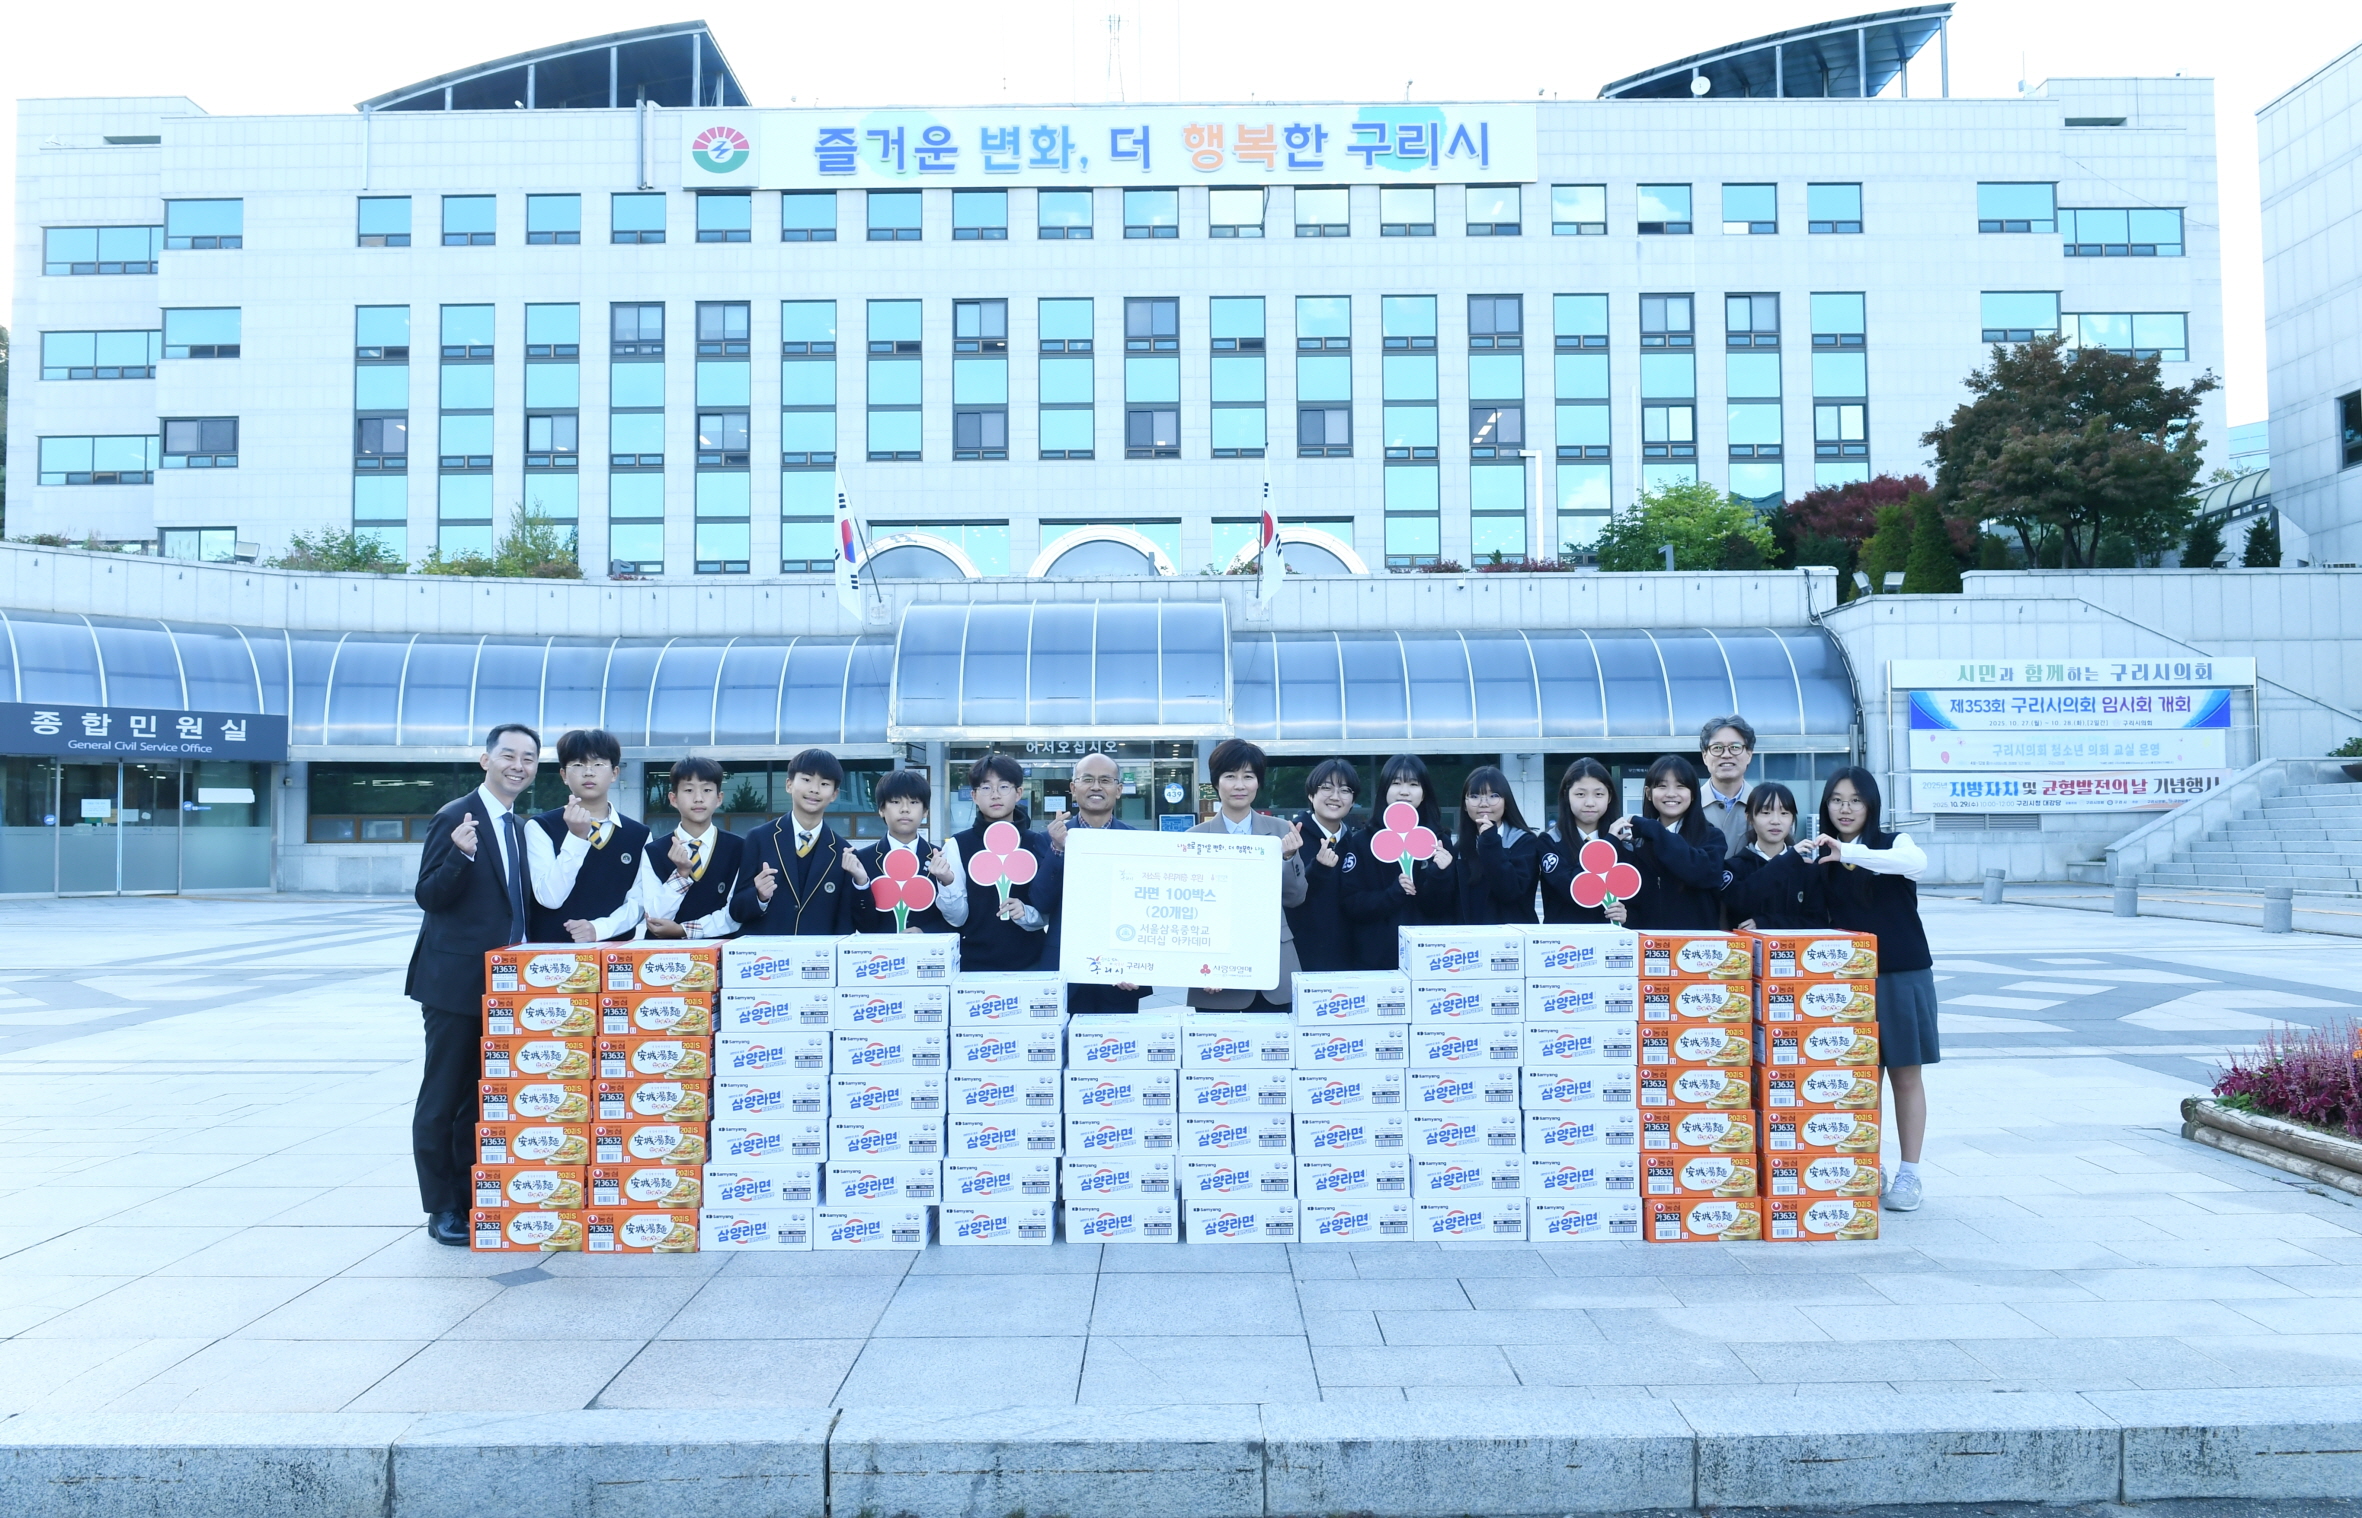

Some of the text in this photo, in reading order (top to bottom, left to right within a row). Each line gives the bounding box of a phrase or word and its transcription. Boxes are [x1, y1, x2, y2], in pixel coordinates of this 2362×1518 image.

[814, 121, 1489, 173] 즐거운 변화, 더 행복한 구리시
[1957, 662, 2213, 683] 시민과 함께하는 구리시의회
[1950, 695, 2191, 714] 제353회 구리시의회 임시회 개회
[68, 739, 212, 753] General Civil Service Office
[1026, 740, 1117, 754] 어서오십시오
[1992, 742, 2161, 757] 구리시의회 청소년 의회 교실 운영
[1950, 781, 2019, 797] 지방자치
[2022, 781, 2036, 795] 및
[1542, 854, 1557, 872] 25
[1134, 886, 1217, 902] 라면 100박스
[1146, 905, 1198, 920] (20개입)
[1140, 923, 1210, 936] 서울삼육중학교
[1137, 935, 1211, 947] 리더십 아카데미
[855, 957, 905, 978] 삼양라면
[1429, 950, 1479, 971] 삼양라면
[1544, 947, 1594, 968] 삼양라면
[740, 958, 790, 979] 삼양라면
[853, 1001, 903, 1022] 삼양라면
[969, 996, 1019, 1017] 삼양라면
[1316, 995, 1366, 1016] 삼양라면
[1430, 994, 1480, 1015] 삼양라면
[1544, 991, 1594, 1012] 삼양라면
[739, 1003, 789, 1024] 삼양라면
[851, 1044, 901, 1065] 삼양라면
[967, 1040, 1017, 1061] 삼양라면
[1086, 1040, 1136, 1061] 삼양라면
[1200, 1040, 1250, 1061] 삼양라면
[1314, 1039, 1364, 1060] 삼양라면
[1429, 1038, 1479, 1059] 삼양라면
[1542, 1036, 1592, 1057] 삼양라면
[733, 1047, 783, 1068] 삼양라면
[850, 1088, 900, 1109] 삼양라면
[965, 1084, 1015, 1105] 삼양라면
[1082, 1084, 1132, 1105] 삼양라면
[1197, 1083, 1247, 1104] 삼양라면
[1311, 1083, 1361, 1104] 삼양라면
[1423, 1081, 1473, 1102] 삼양라면
[1541, 1080, 1591, 1101] 삼양라면
[731, 1091, 781, 1112] 삼양라면
[848, 1131, 898, 1152] 삼양라면
[966, 1128, 1016, 1149] 삼양라면
[1083, 1127, 1133, 1148] 삼양라면
[1198, 1126, 1248, 1147] 삼양라면
[1314, 1126, 1364, 1147] 삼양라면
[1426, 1124, 1476, 1145] 삼양라면
[1544, 1123, 1594, 1144] 삼양라면
[730, 1134, 780, 1155] 삼양라면
[845, 1176, 895, 1197] 삼양라면
[961, 1173, 1011, 1194] 삼양라면
[1080, 1171, 1130, 1192] 삼양라면
[1200, 1170, 1250, 1191] 삼양라면
[1315, 1170, 1365, 1191] 삼양라면
[1430, 1168, 1480, 1189] 삼양라면
[1544, 1168, 1594, 1189] 삼양라면
[721, 1179, 771, 1200] 삼양라면
[717, 1222, 767, 1243] 삼양라면
[831, 1221, 881, 1242] 삼양라면
[957, 1216, 1007, 1237] 삼양라면
[1083, 1214, 1133, 1235] 삼양라면
[1205, 1214, 1255, 1235] 삼양라면
[1319, 1213, 1369, 1234] 삼양라면
[1432, 1212, 1482, 1233] 삼양라면
[1548, 1212, 1598, 1233] 삼양라면
